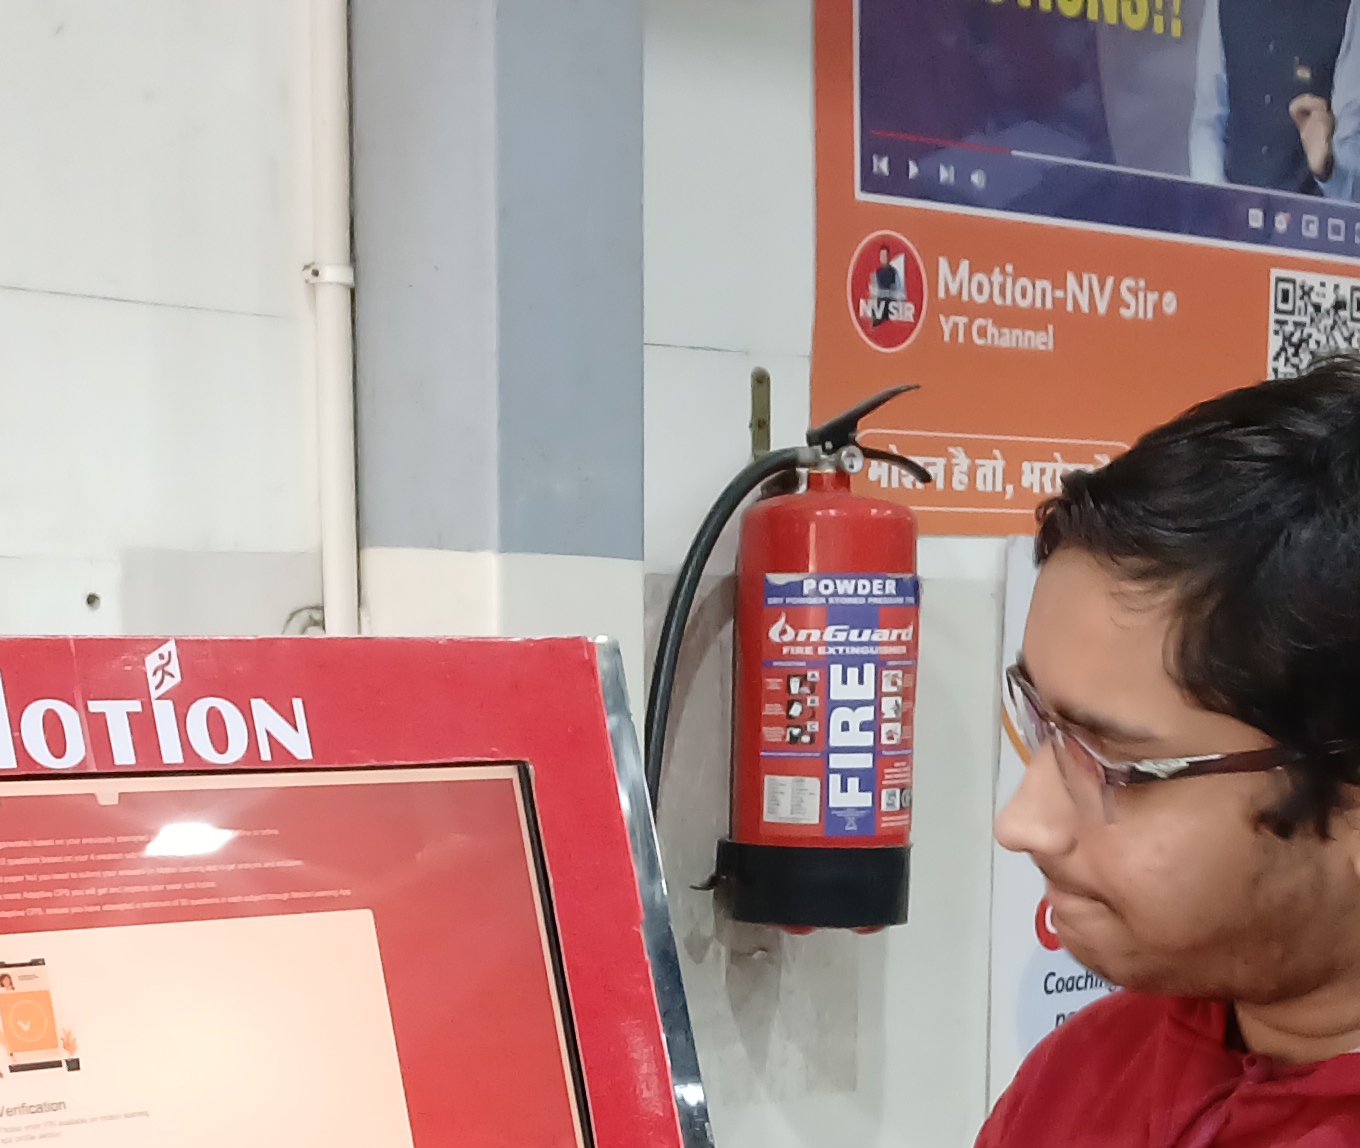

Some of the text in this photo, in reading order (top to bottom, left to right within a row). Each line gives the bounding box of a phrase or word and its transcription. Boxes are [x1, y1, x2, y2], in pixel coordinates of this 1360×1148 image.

[859, 298, 915, 322] NV SIR
[938, 256, 1159, 320] Motion-NV Sir
[939, 314, 1054, 351] YT Channel
[948, 446, 971, 491] है
[975, 449, 1015, 500] तो,
[803, 578, 896, 596] POWDER
[829, 663, 875, 807] FIRE
